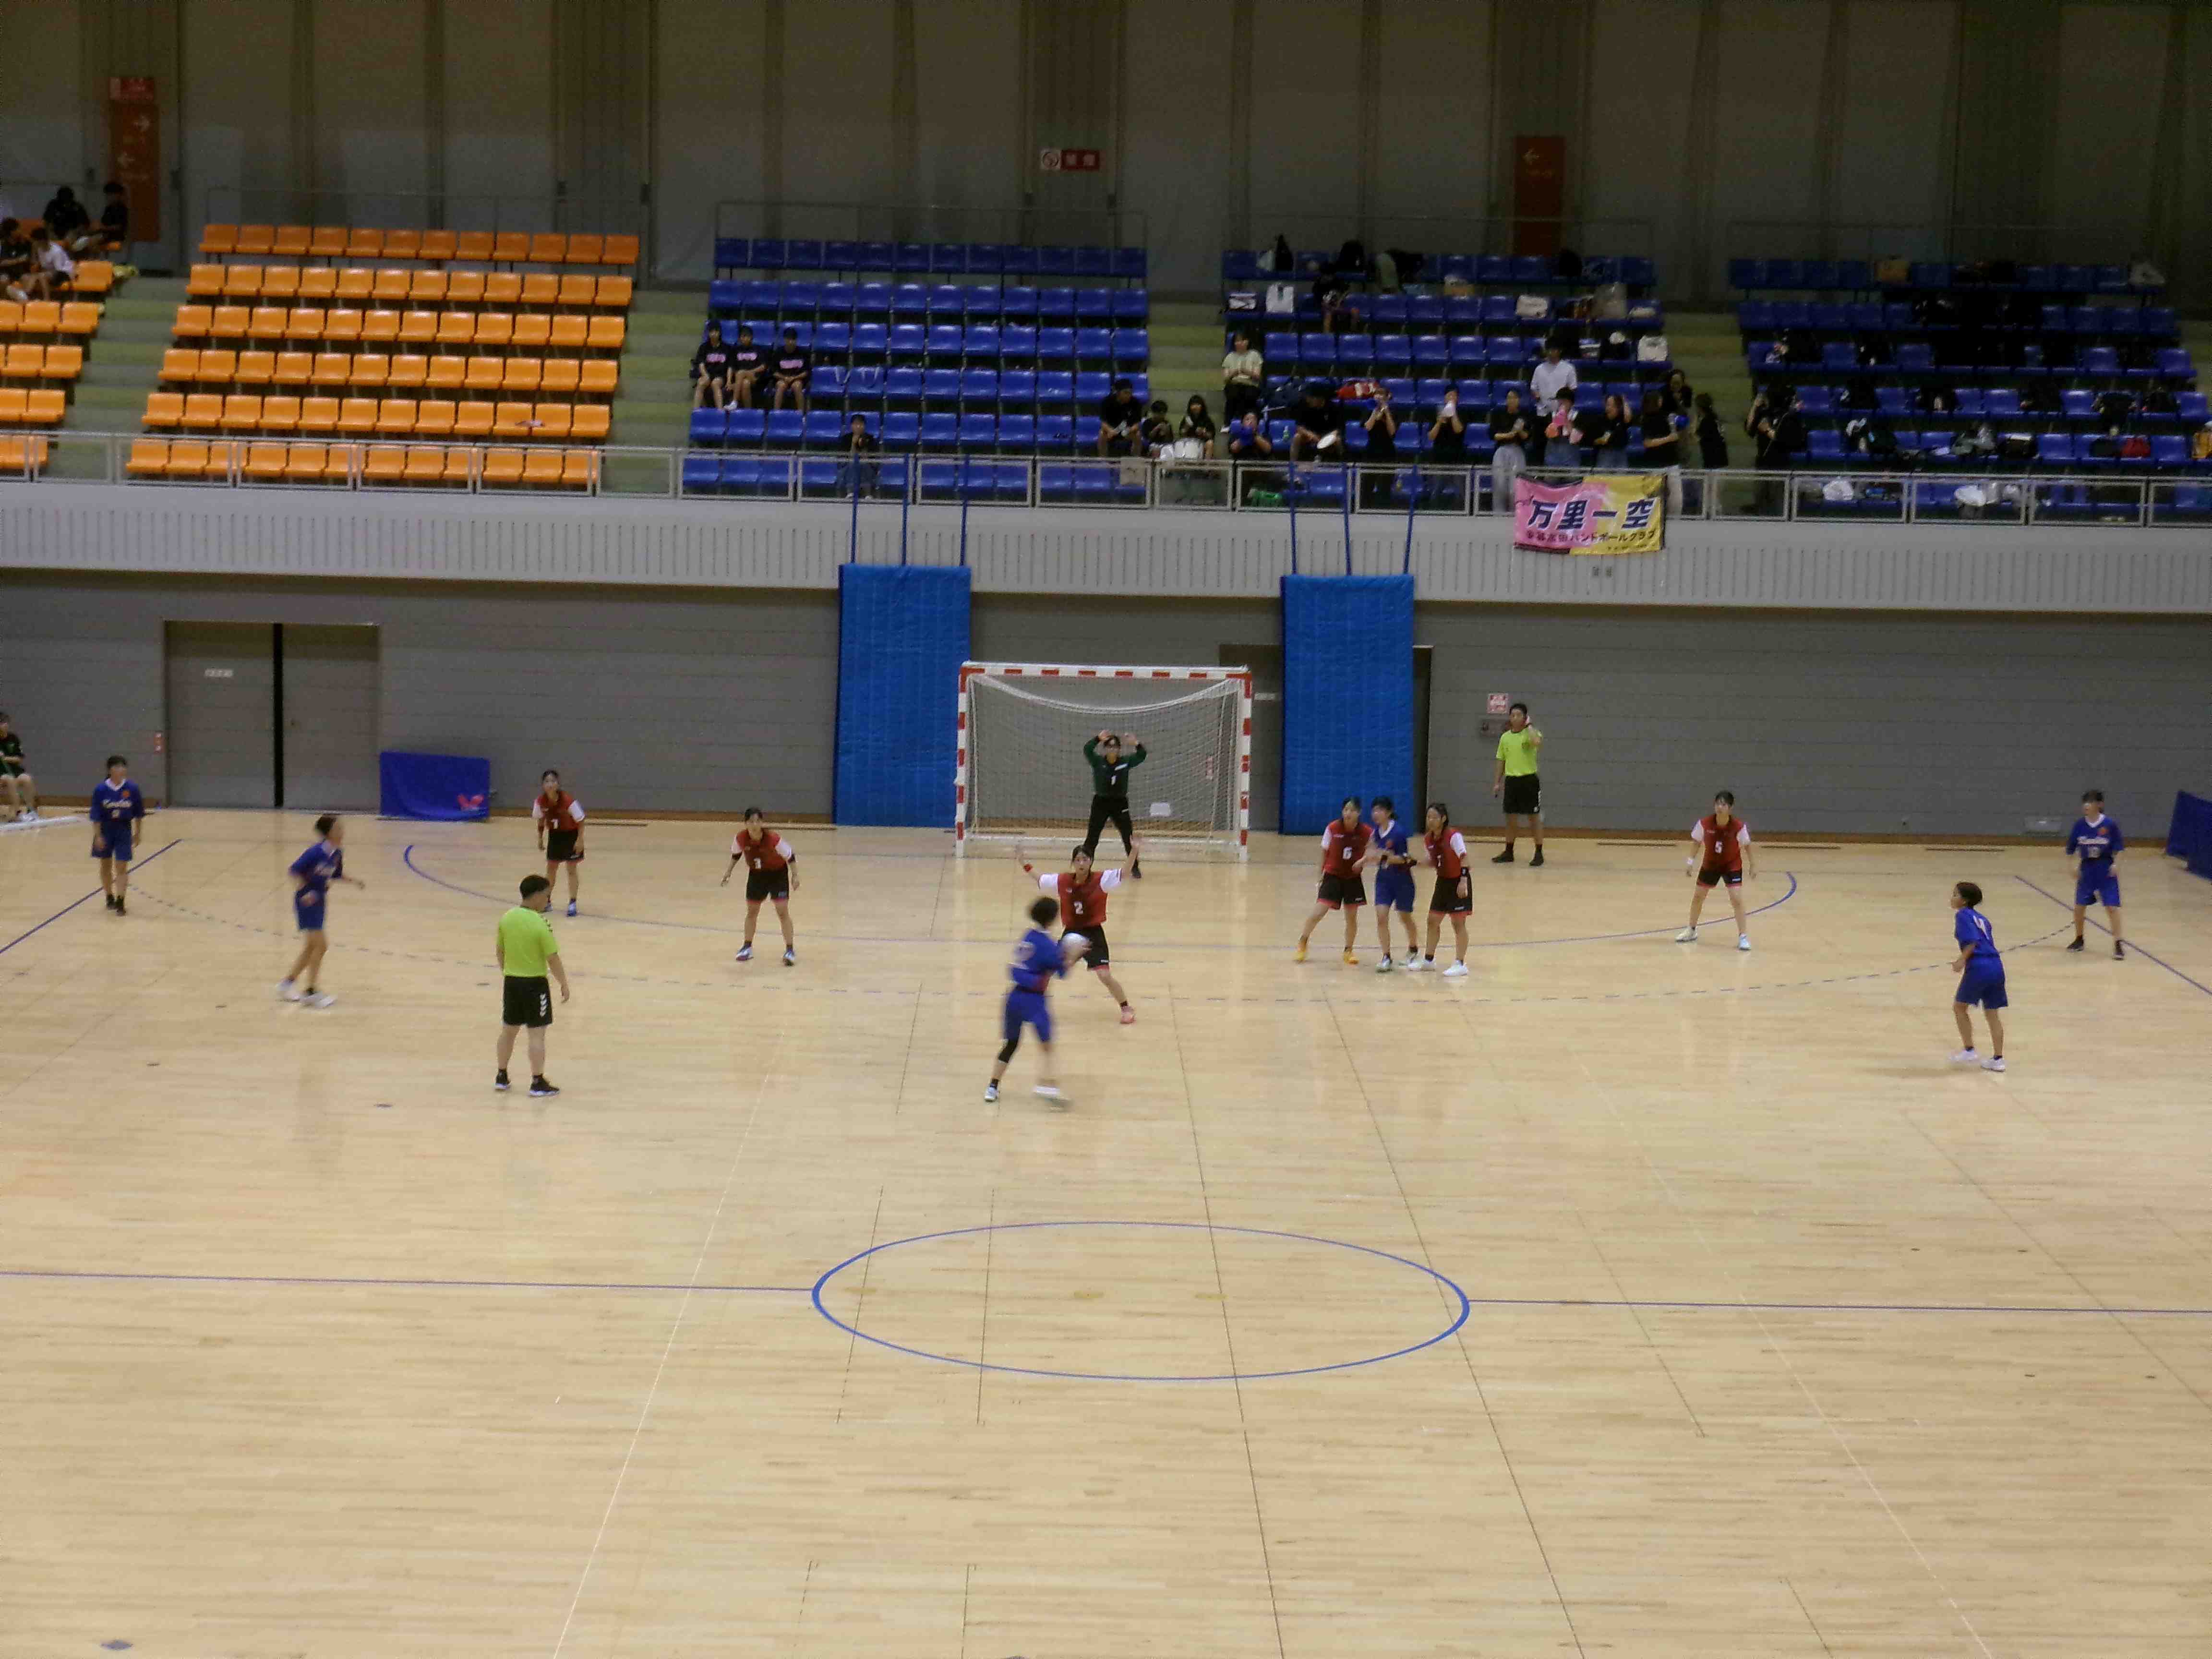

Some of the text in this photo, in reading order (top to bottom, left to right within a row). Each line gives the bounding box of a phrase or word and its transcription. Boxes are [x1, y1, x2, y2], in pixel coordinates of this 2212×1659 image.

[1527, 499, 1655, 530] 万里一空
[1073, 901, 1084, 914] 2
